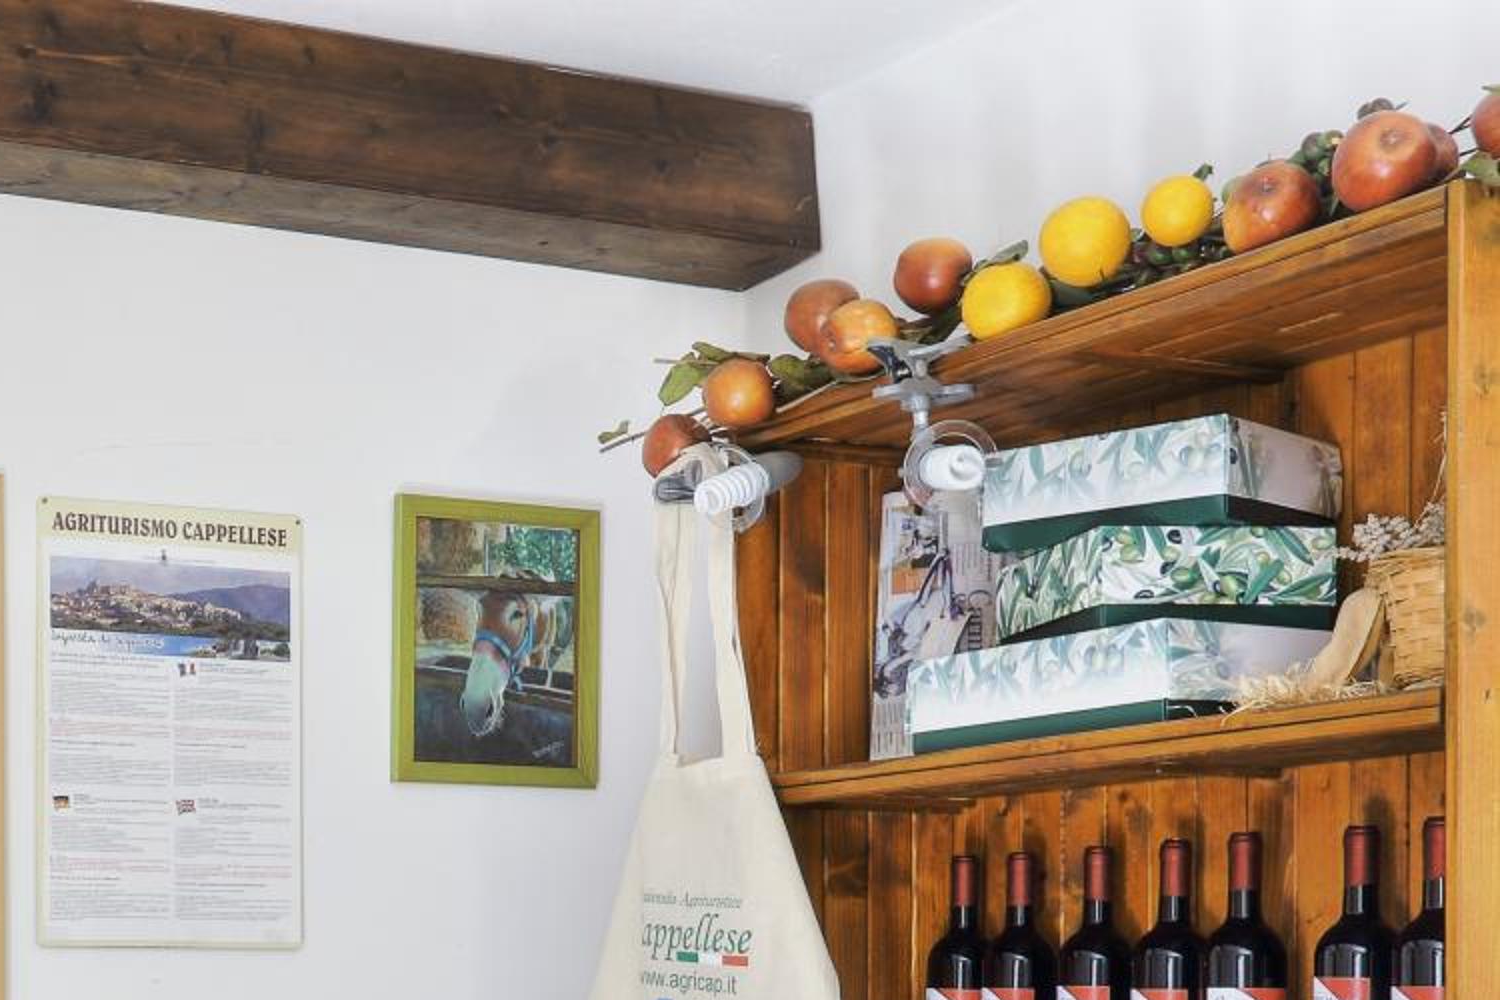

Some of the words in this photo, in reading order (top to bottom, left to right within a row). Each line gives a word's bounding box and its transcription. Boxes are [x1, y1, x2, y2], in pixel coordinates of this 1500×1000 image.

[51, 511, 177, 539] AGRITURISMO
[183, 521, 287, 547] CAPPELLESE
[642, 913, 751, 960] appellese
